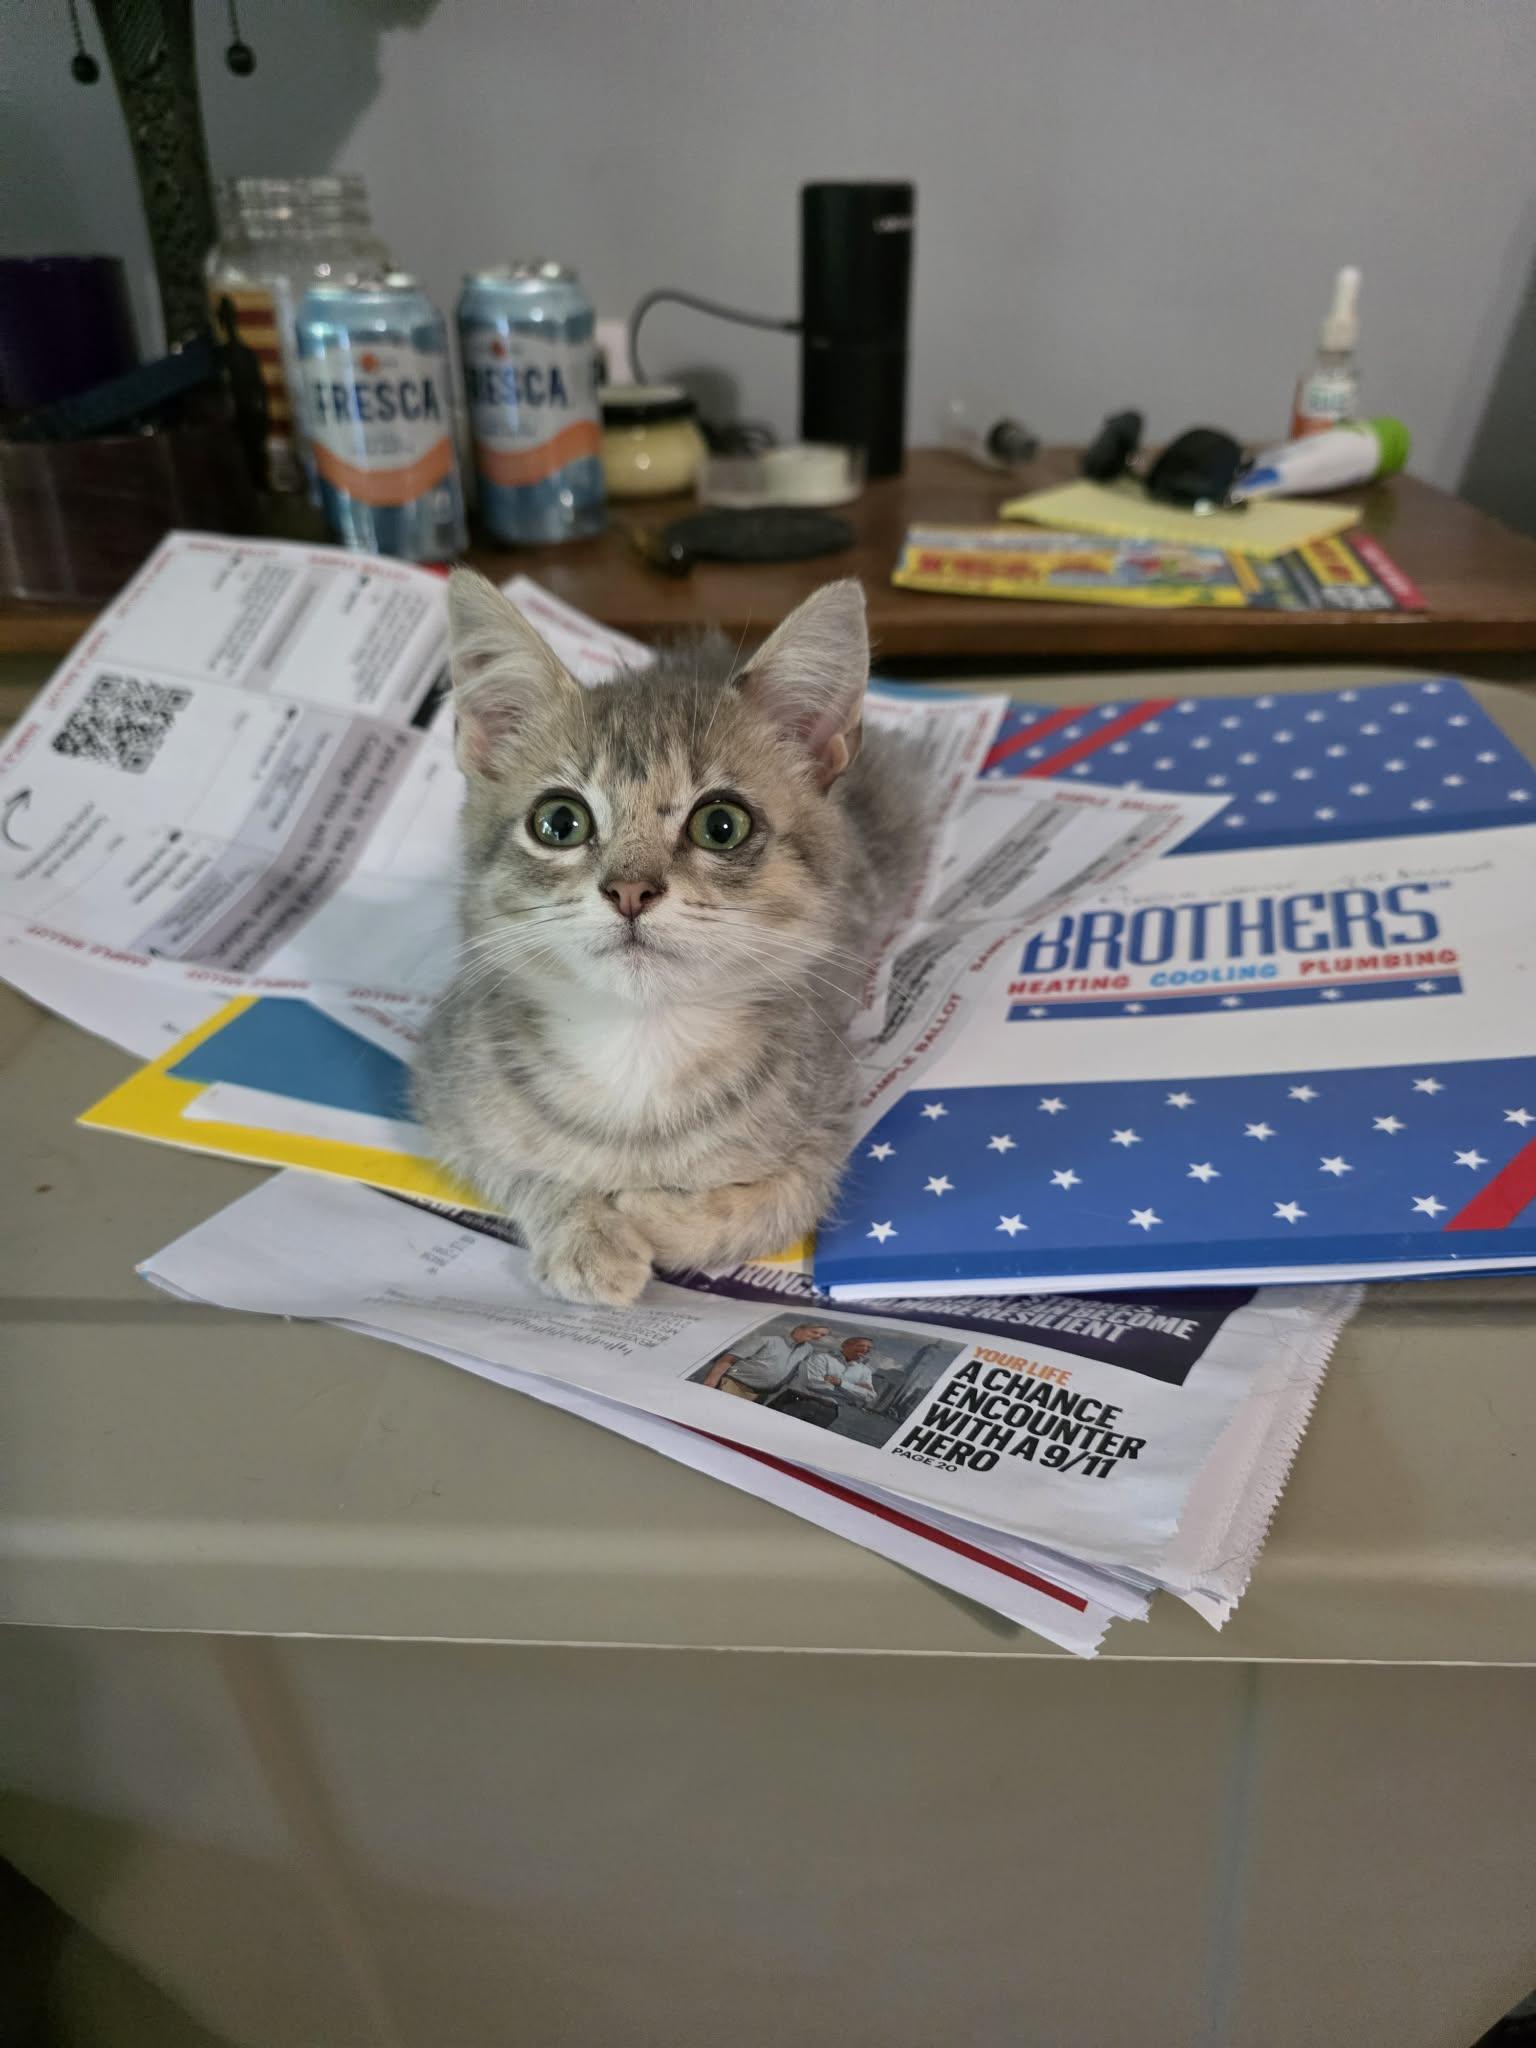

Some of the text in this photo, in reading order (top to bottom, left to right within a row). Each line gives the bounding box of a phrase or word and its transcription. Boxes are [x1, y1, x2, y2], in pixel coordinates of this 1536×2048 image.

[312, 377, 441, 423] FRESCA
[1007, 947, 1460, 997] HEATING COOLING PLUMBING
[860, 1056, 917, 1108] SAMPLE
[914, 992, 962, 1054] BALLOT
[971, 1305, 1133, 1344] RESILIENT
[1068, 1305, 1200, 1341] BECOME
[973, 1345, 1073, 1386] YOUR LIFE
[953, 1360, 1123, 1430] A CHANCE
[921, 1402, 1119, 1479] WITH A 9/11
[936, 1380, 1148, 1460] ENCOUNTER
[891, 1446, 958, 1473] PAGE 20
[900, 1425, 1001, 1473] HERO
